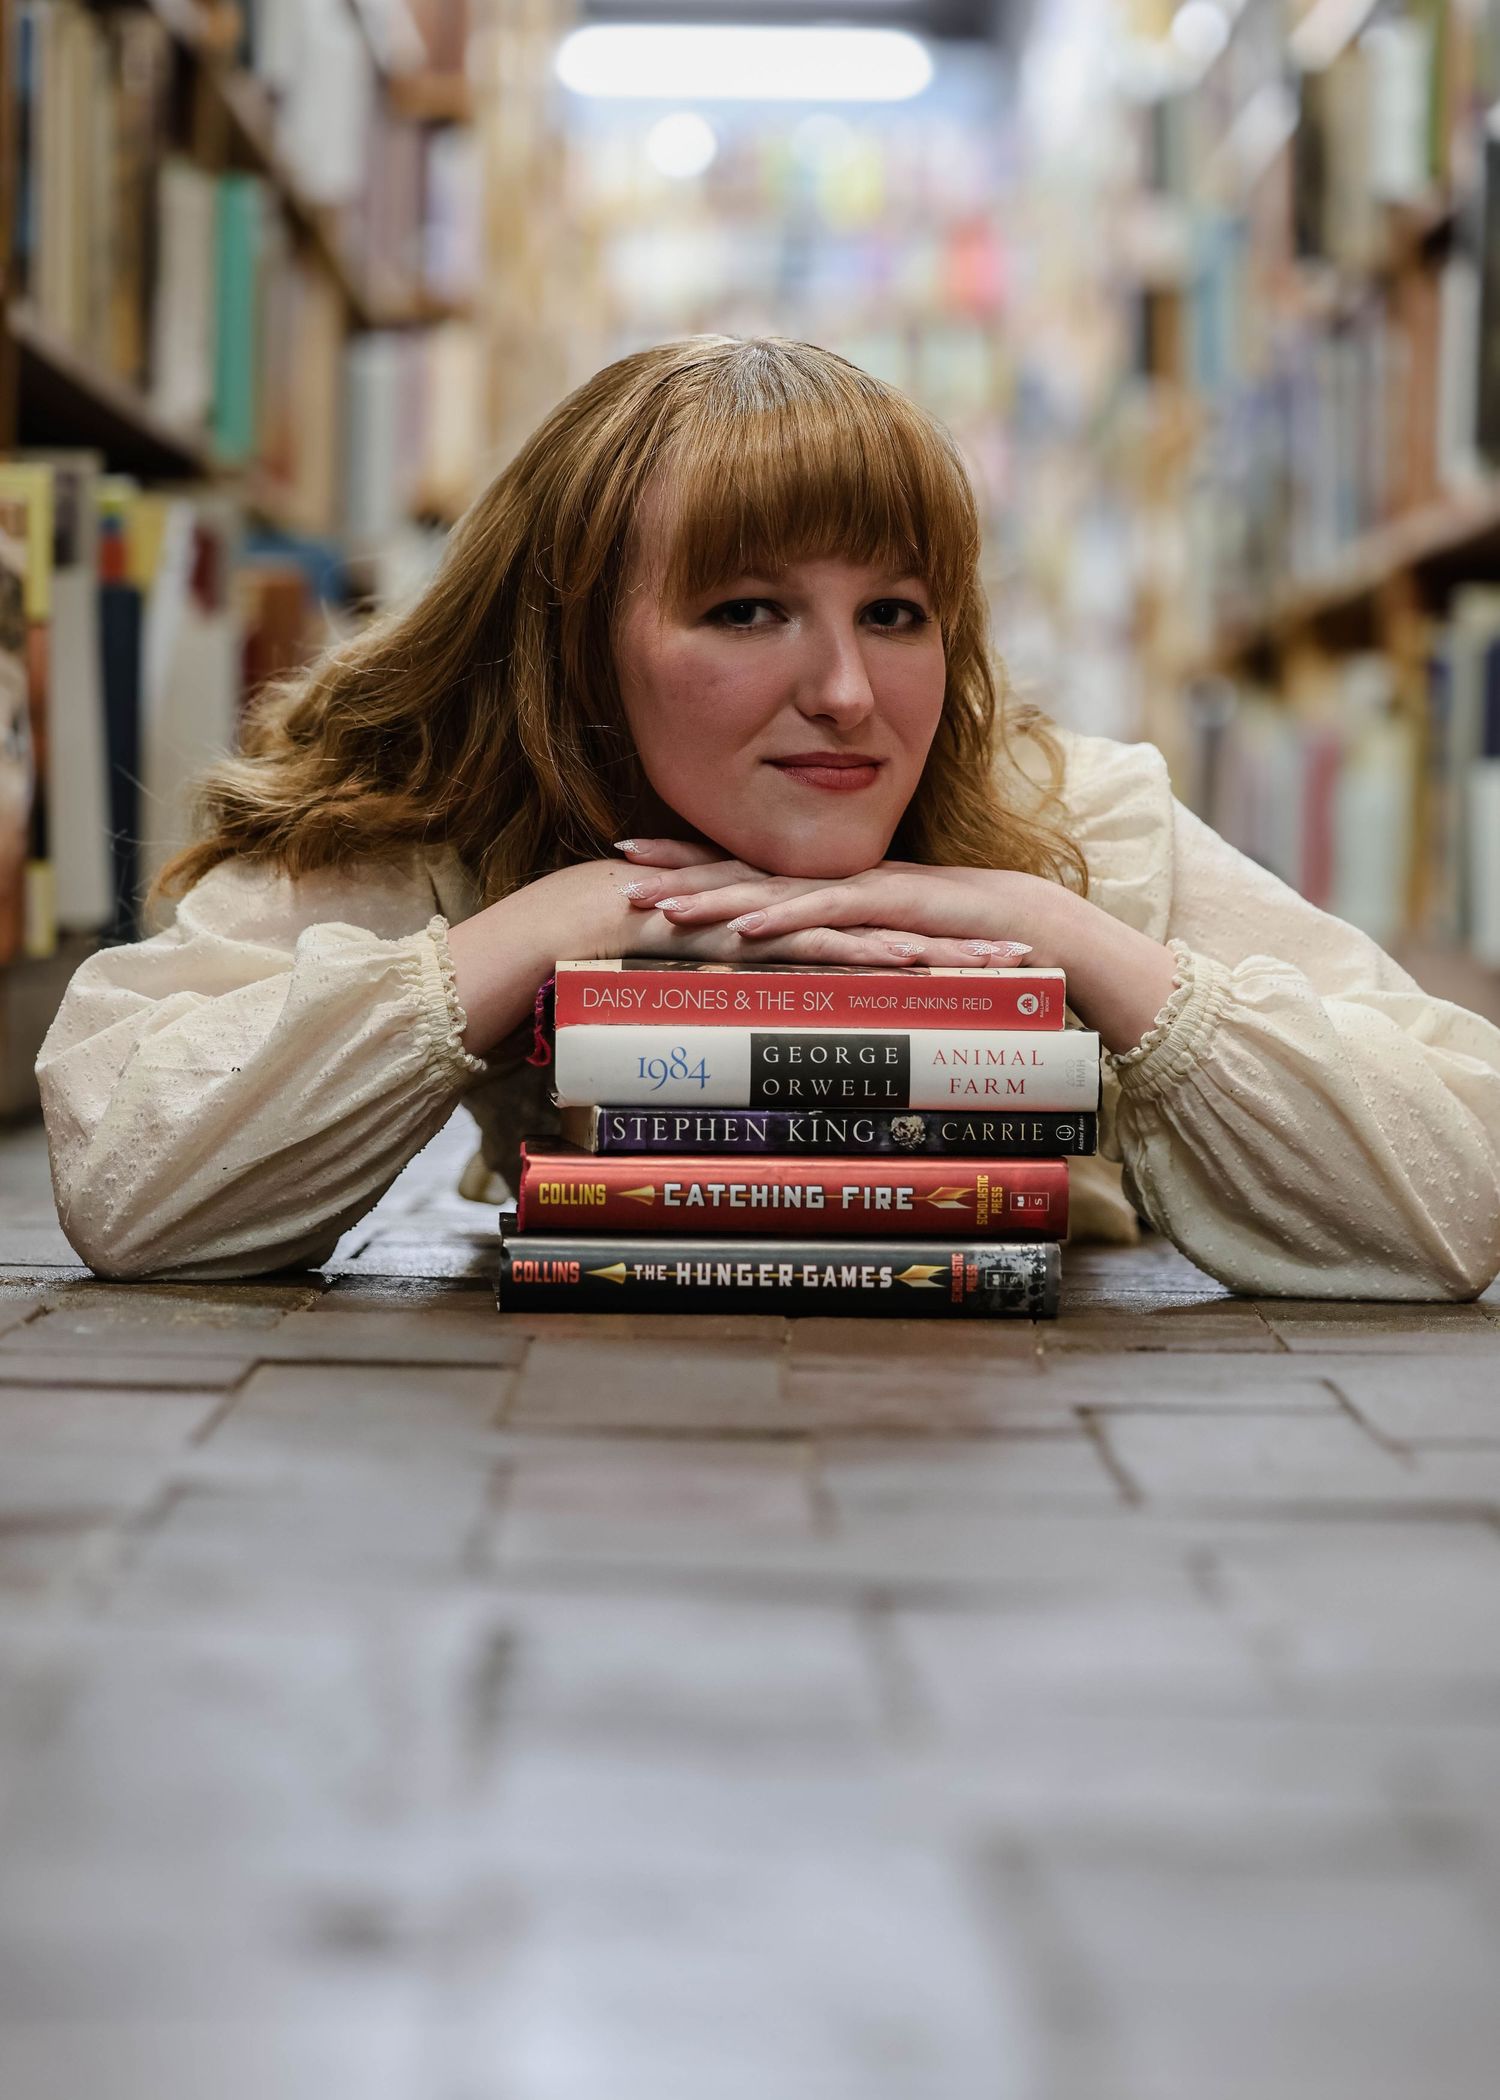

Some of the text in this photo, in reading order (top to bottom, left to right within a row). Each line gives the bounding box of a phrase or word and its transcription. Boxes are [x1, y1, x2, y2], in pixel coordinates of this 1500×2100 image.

[583, 988, 834, 1011] DAISY JONES & THE SIX
[848, 996, 992, 1011] TAYLOR JENKINS REID
[763, 1046, 899, 1065] GEORGE
[932, 1049, 1044, 1066] ANIMAL
[638, 1046, 711, 1091] 1984
[1076, 1059, 1086, 1087] HMH
[762, 1079, 898, 1097] ORWELL
[950, 1078, 1026, 1095] FARM
[611, 1117, 875, 1143] STEPHEN KING
[941, 1122, 1044, 1141] CARRIE
[538, 1183, 606, 1205] COLLINS
[664, 1183, 914, 1210] CATCHING FIRE
[976, 1174, 989, 1225] SCHOLASTIC
[991, 1186, 1003, 1214] PRESS
[511, 1260, 580, 1283] COLLINS
[634, 1262, 893, 1289] THE HUNGER GAMES
[951, 1253, 964, 1303] SCHOLASTIC
[966, 1264, 978, 1292] PRESS
